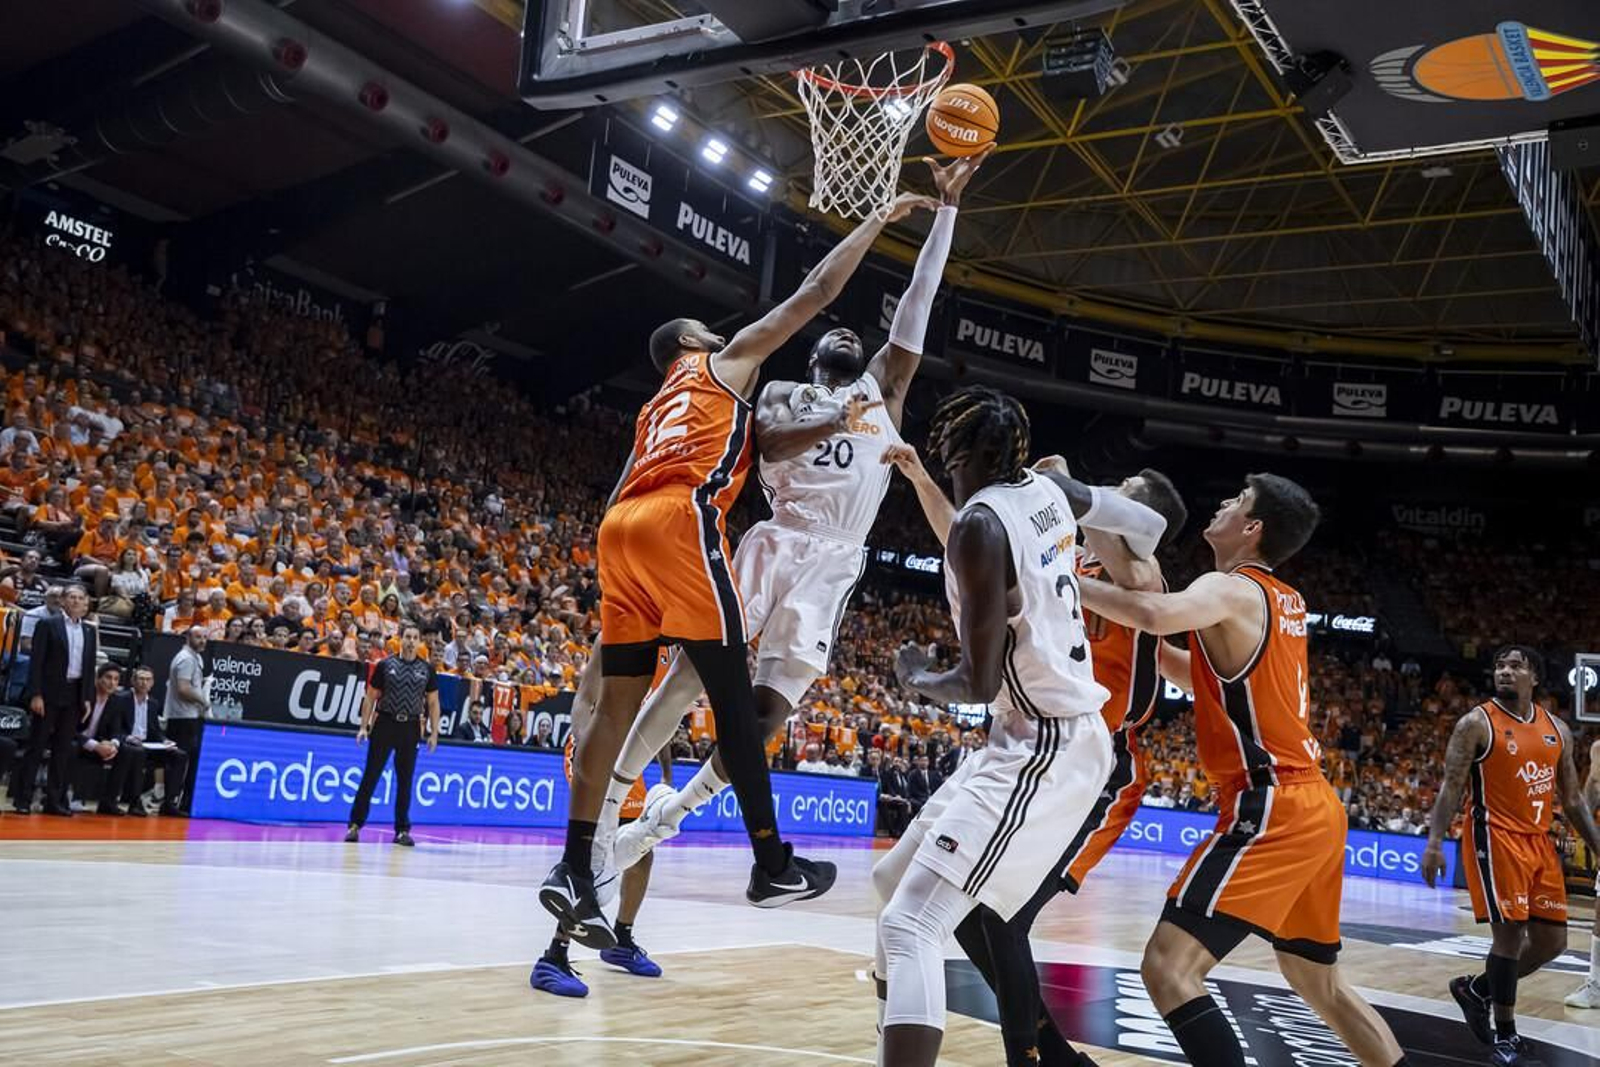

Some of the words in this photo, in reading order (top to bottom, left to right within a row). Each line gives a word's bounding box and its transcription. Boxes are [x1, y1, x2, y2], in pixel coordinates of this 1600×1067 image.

[1503, 28, 1529, 63] BASKET
[934, 115, 979, 142] Wilson
[612, 162, 649, 191] PULEVA
[44, 210, 113, 248] AMSTEL
[676, 201, 750, 265] PULEVA
[957, 318, 1045, 363] PULEVA
[1094, 353, 1134, 369] PULEVA
[1180, 371, 1281, 406] PULEVA
[1337, 387, 1384, 398] PULEVA
[645, 391, 691, 455] 12
[1438, 396, 1559, 425] PULEVA
[813, 439, 854, 469] 20
[212, 655, 262, 676] valencia
[416, 765, 555, 811] endesa
[792, 790, 869, 824] endesa
[1531, 800, 1544, 825] 7
